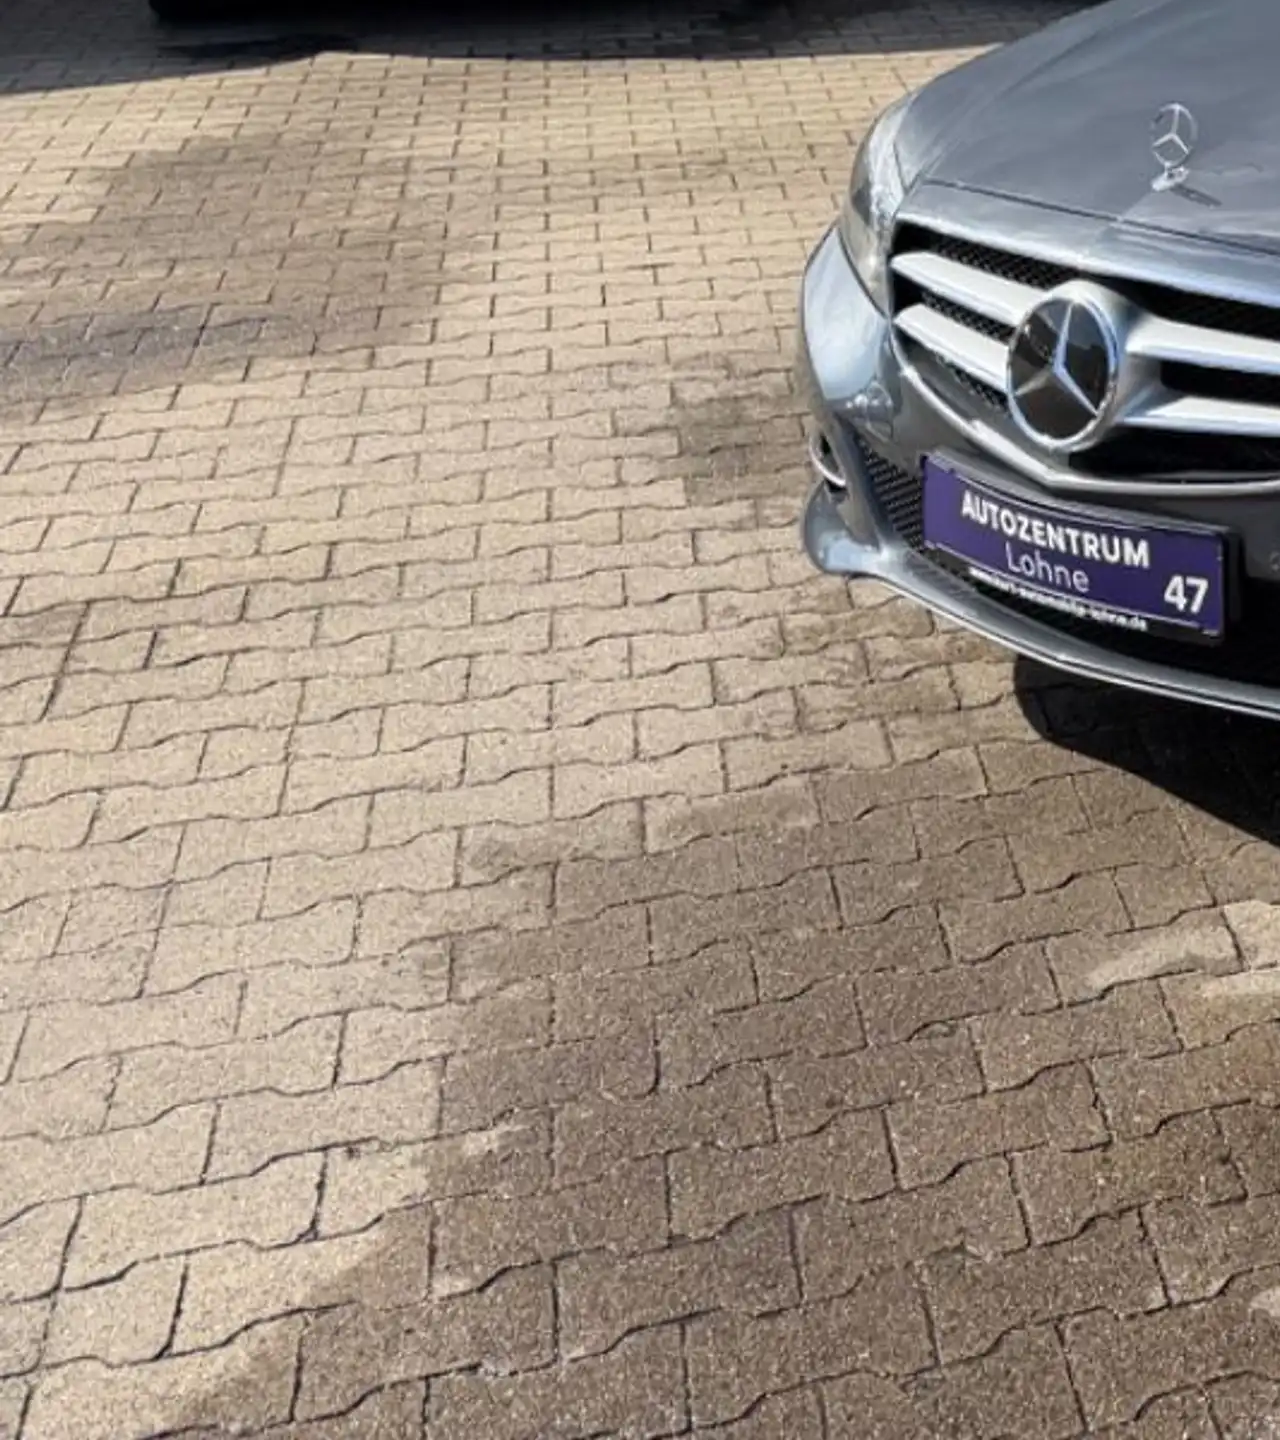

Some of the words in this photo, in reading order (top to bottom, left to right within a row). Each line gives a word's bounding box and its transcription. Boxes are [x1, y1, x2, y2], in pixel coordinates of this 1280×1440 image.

[961, 488, 1150, 569] AUTOZENTRUM
[1004, 541, 1090, 594] Lohne
[1163, 574, 1209, 613] 47
